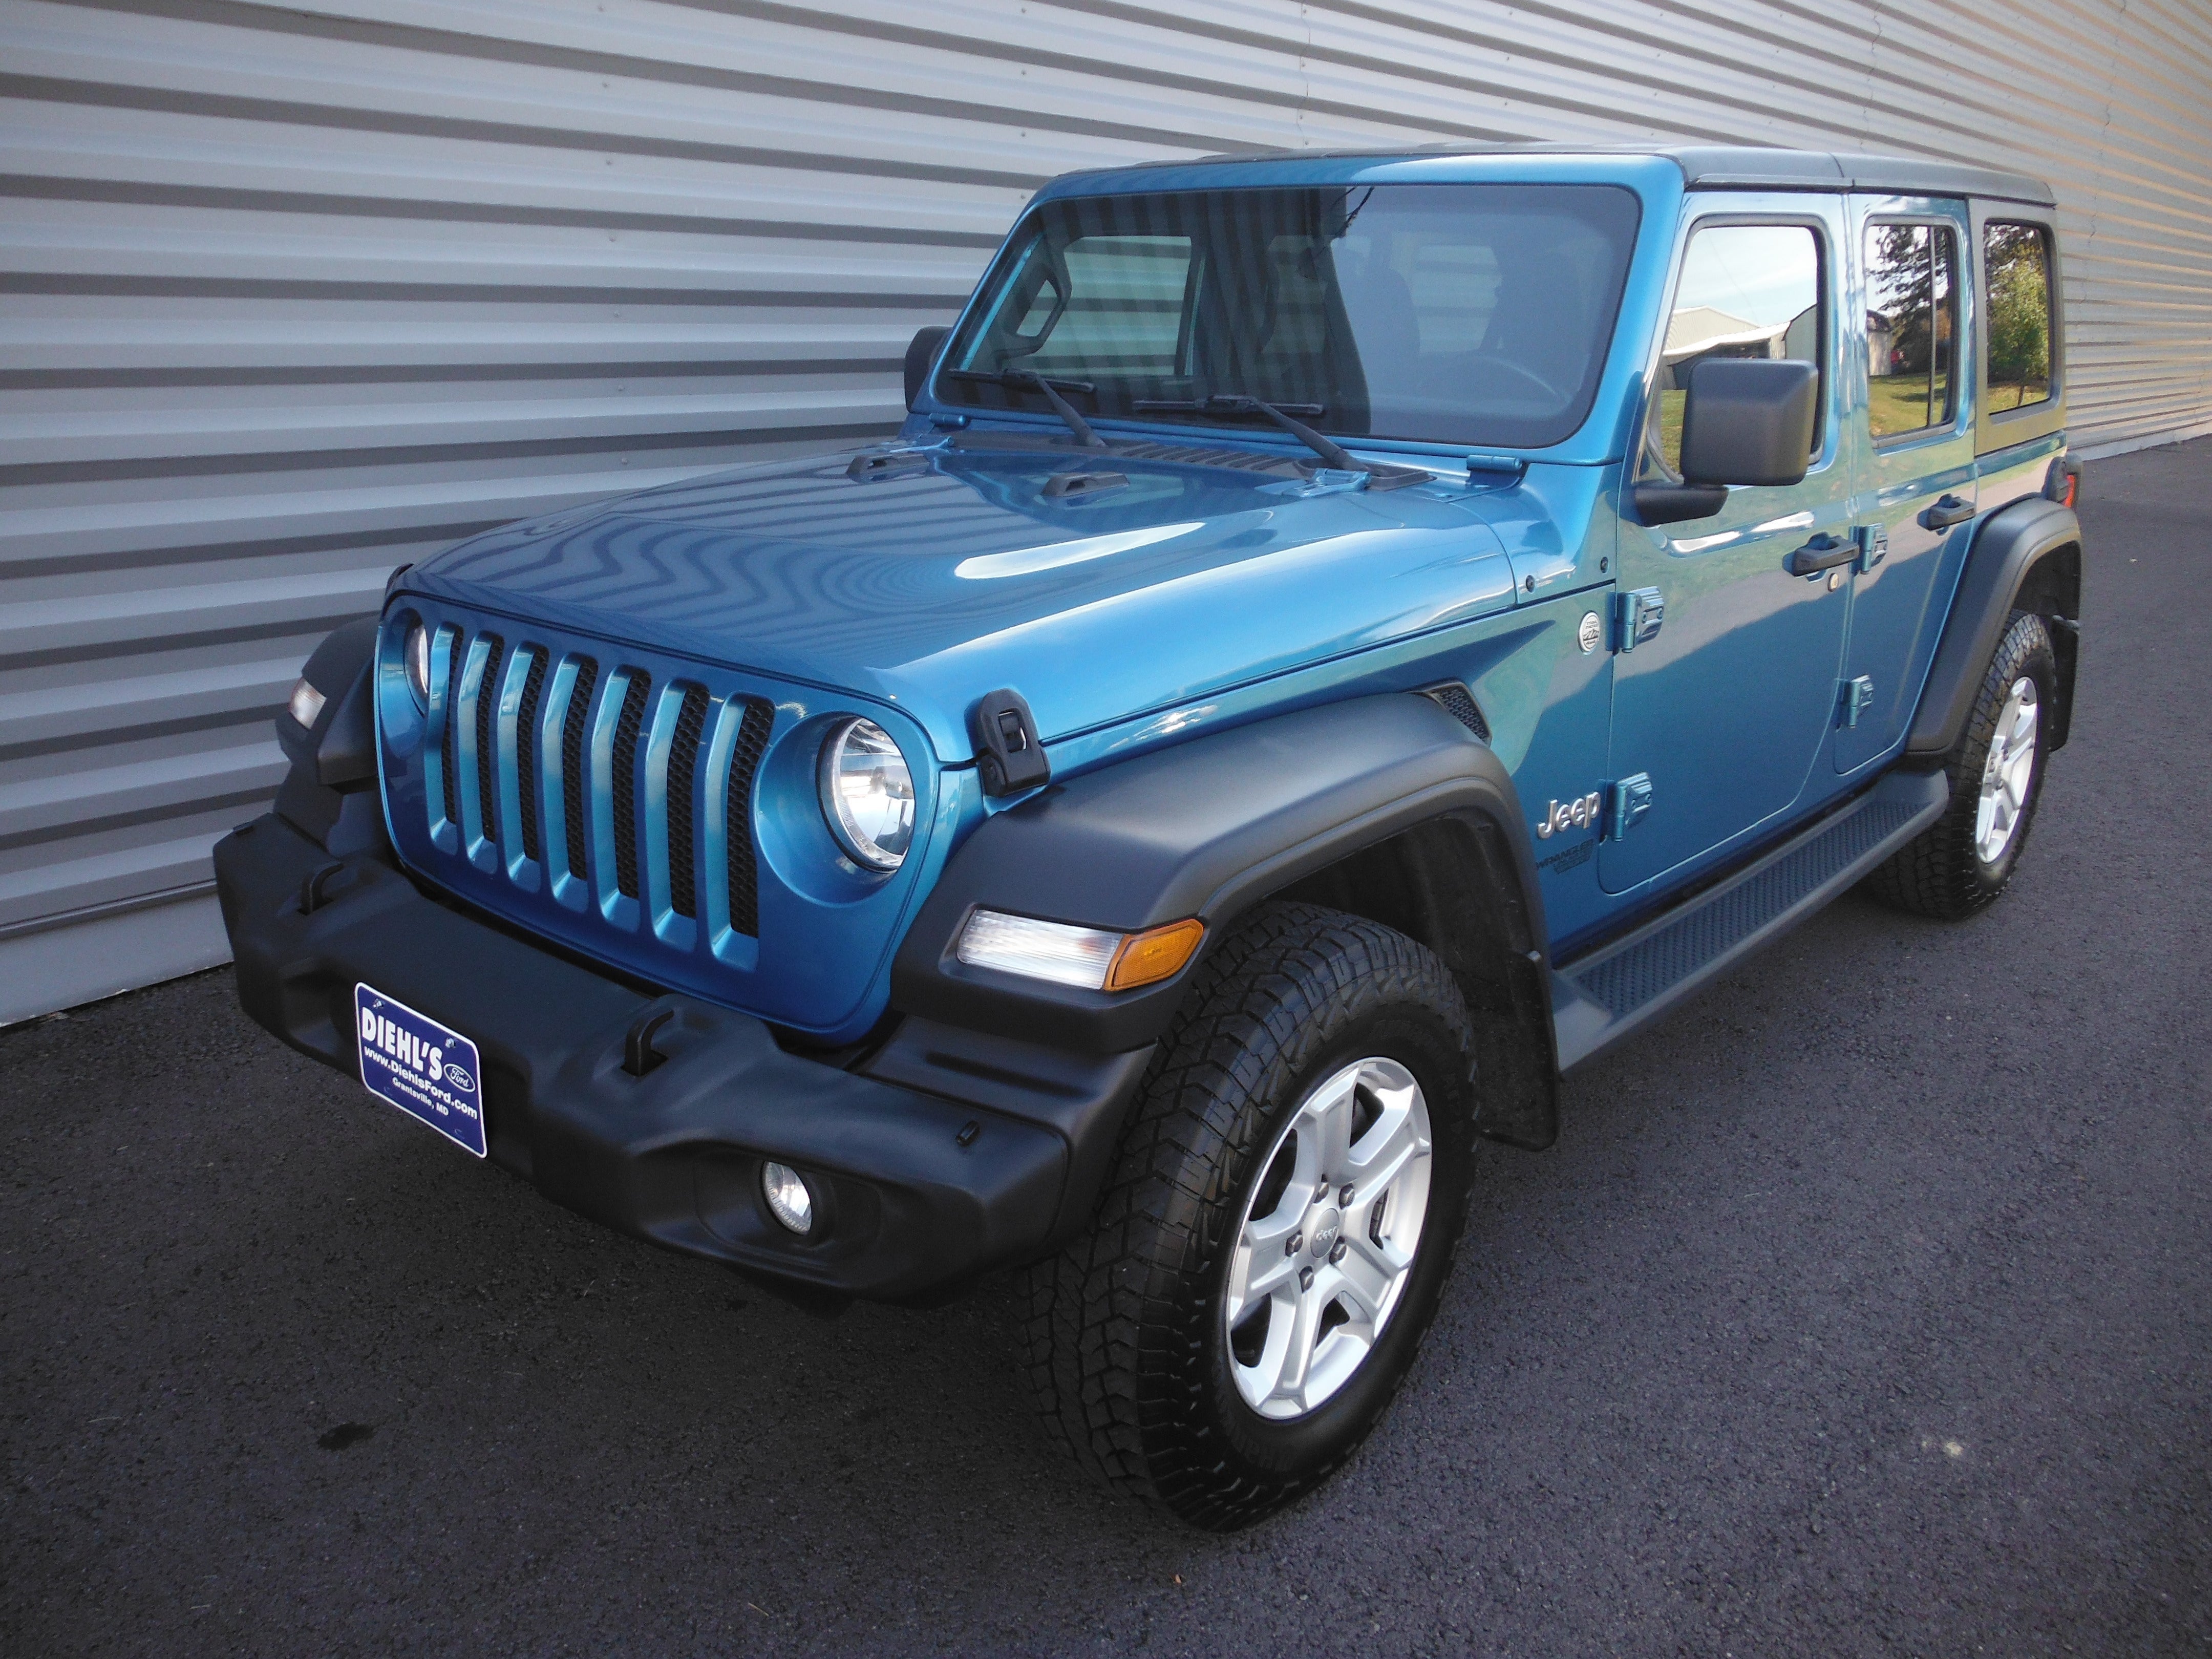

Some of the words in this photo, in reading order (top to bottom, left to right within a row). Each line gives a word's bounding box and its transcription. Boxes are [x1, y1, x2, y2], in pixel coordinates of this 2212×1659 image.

[1538, 792, 1601, 839] Jeep
[362, 1006, 443, 1080] DIEHL'S
[364, 1046, 478, 1120] www.DiehlsFord.com
[392, 1077, 435, 1110] Grantsville,
[436, 1102, 449, 1116] MD
[450, 1067, 469, 1088] Ford
